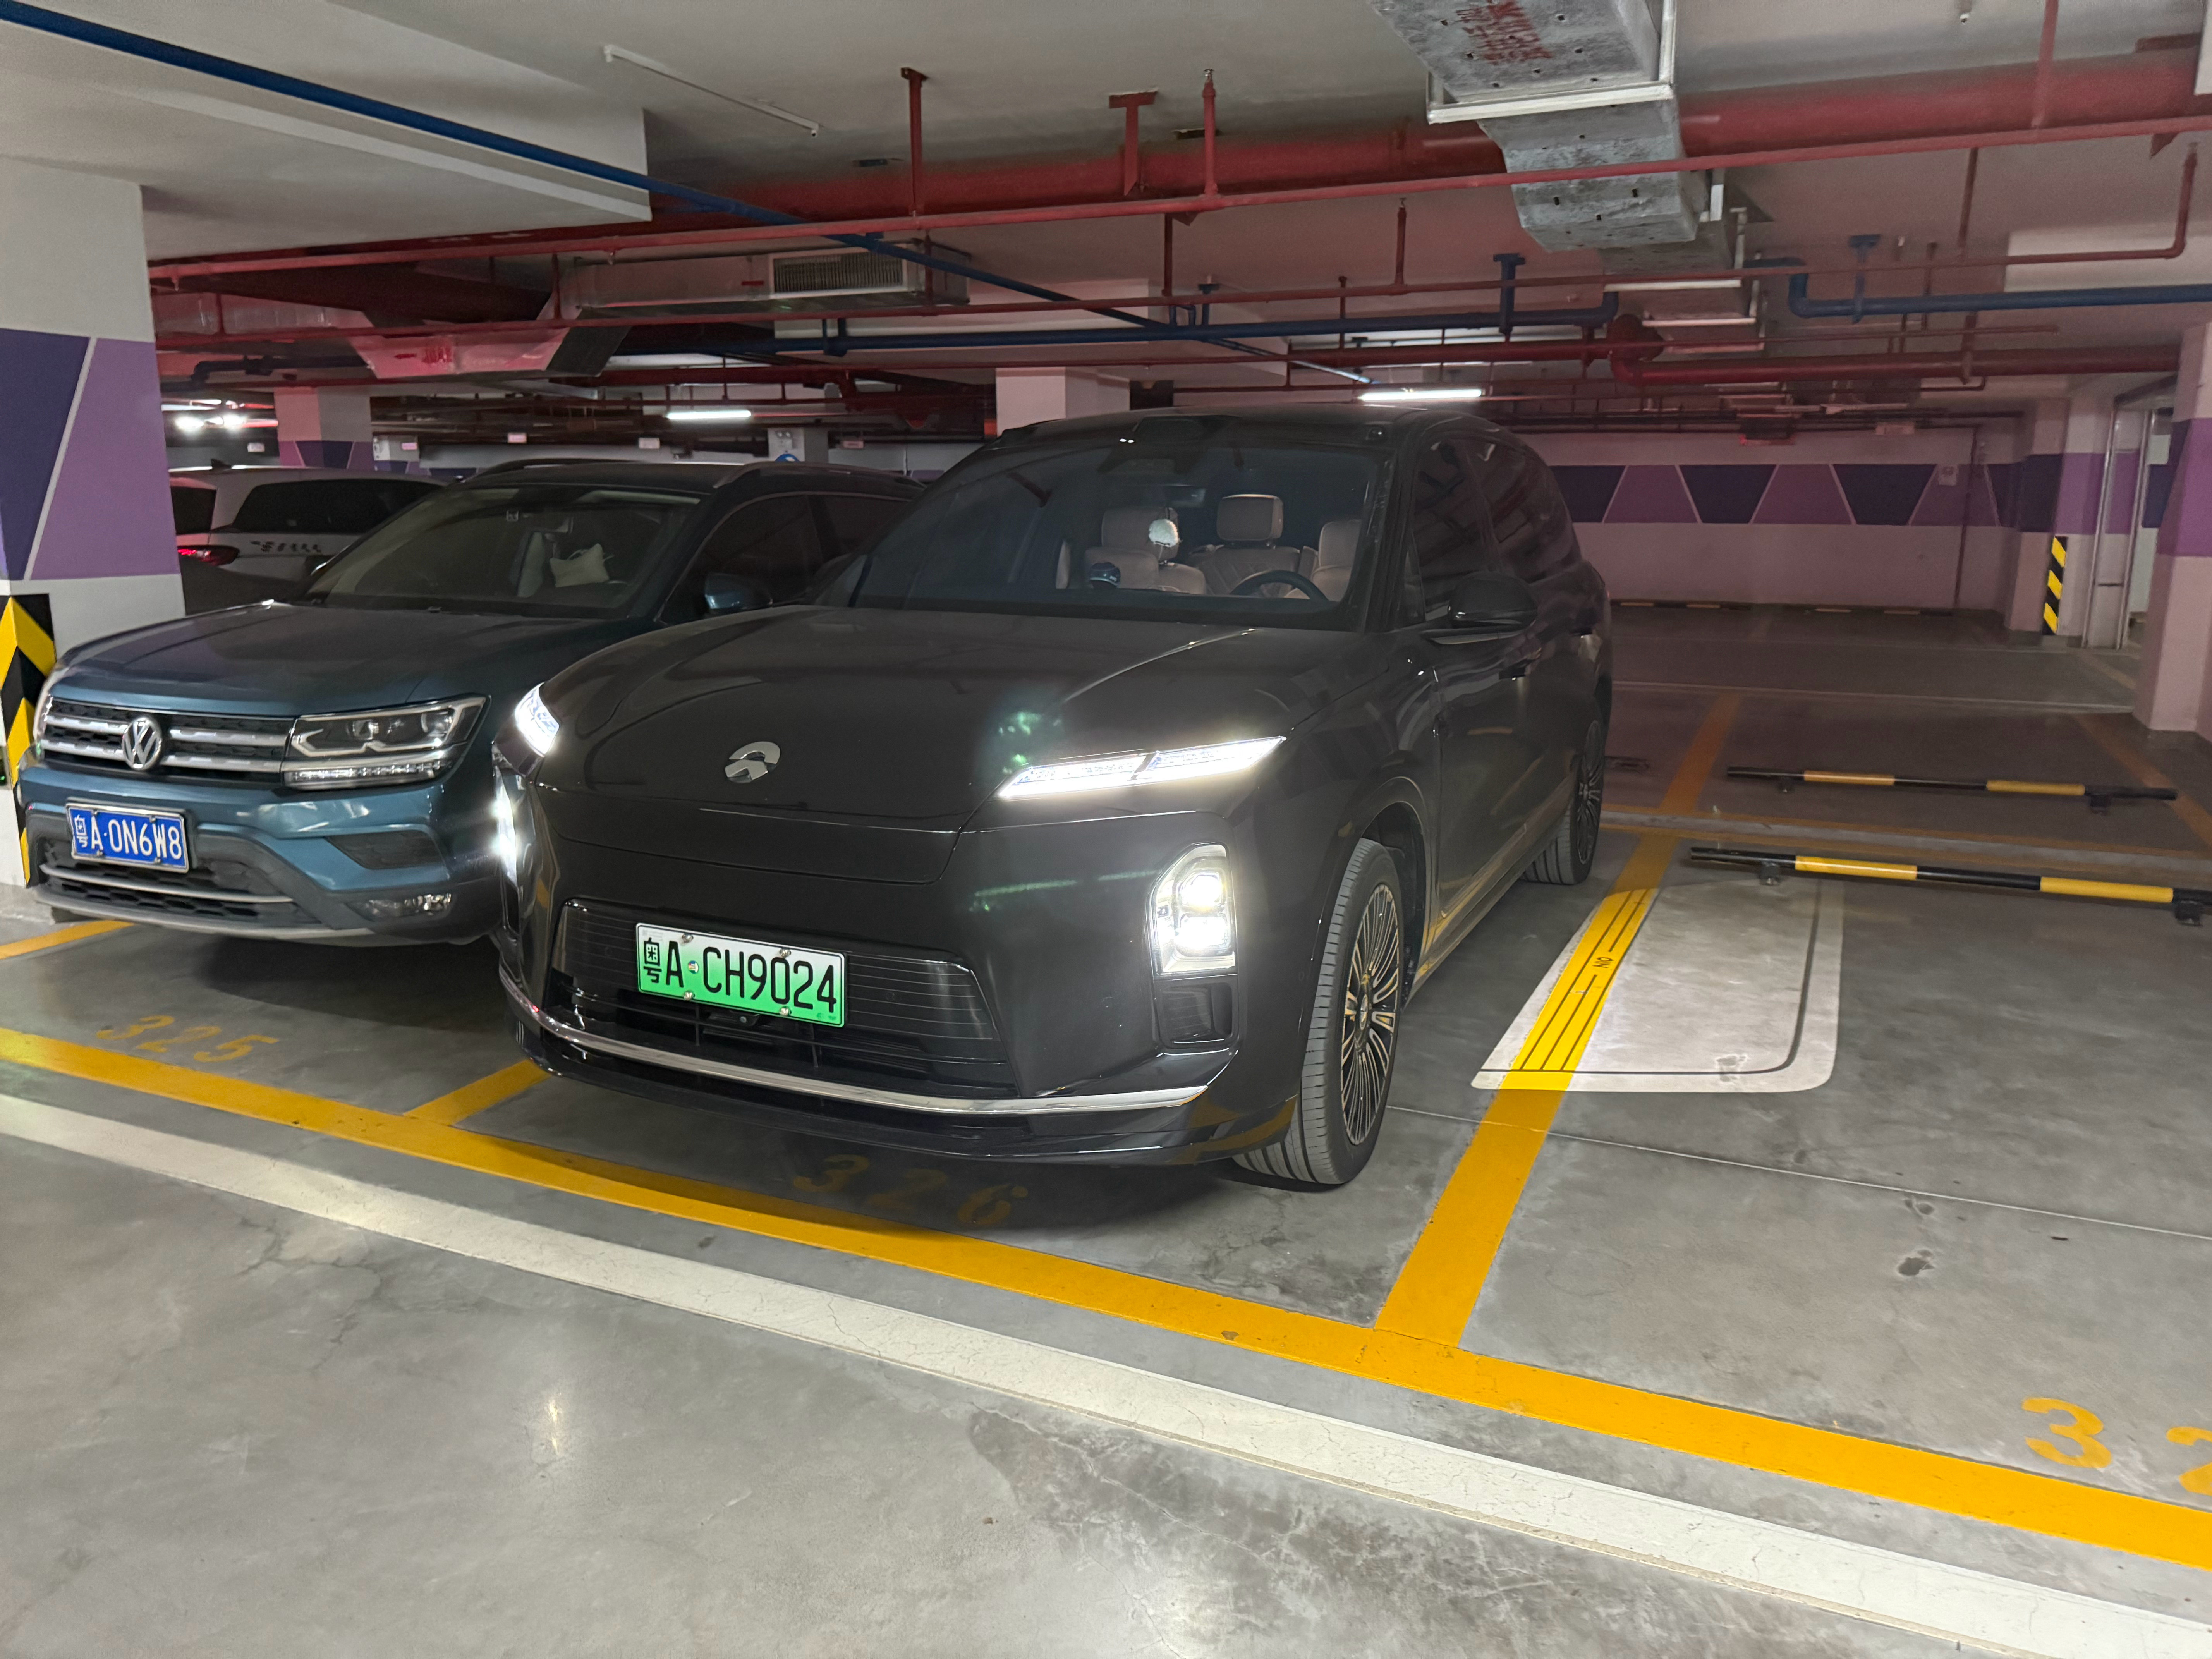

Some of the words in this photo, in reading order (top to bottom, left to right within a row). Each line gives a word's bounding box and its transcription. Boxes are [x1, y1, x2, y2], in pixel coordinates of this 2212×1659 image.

[1592, 957, 1614, 968] NIO
[96, 1015, 280, 1063] 325
[793, 1154, 1029, 1226] 326
